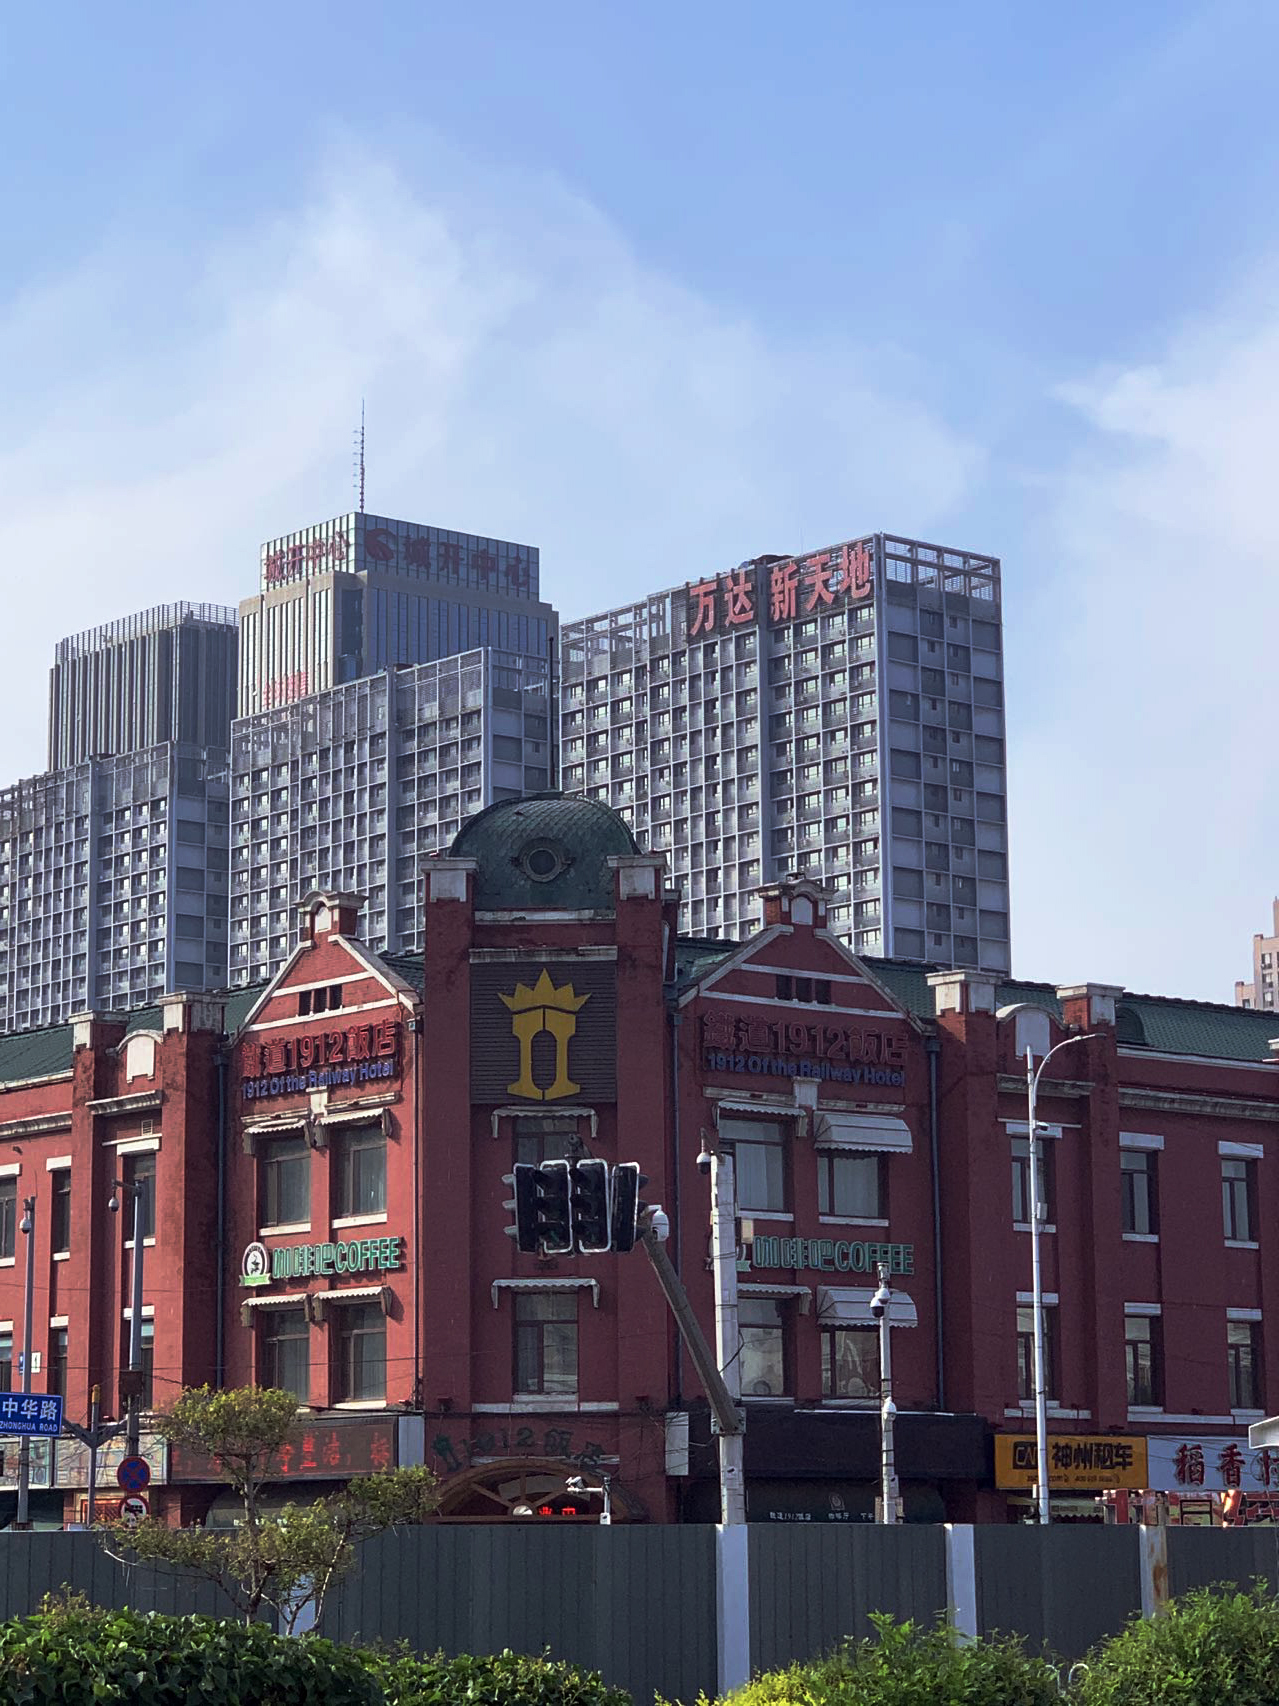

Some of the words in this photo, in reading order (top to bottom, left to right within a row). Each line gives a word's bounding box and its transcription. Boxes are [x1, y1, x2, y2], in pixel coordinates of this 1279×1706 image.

[689, 542, 871, 636] 万达新天地
[243, 1080, 268, 1099] 1912
[284, 1074, 306, 1092] the
[308, 1067, 359, 1088] Railway
[359, 1059, 394, 1080] Hotel
[708, 1053, 745, 1073] 1912
[749, 1055, 768, 1074] Of
[769, 1057, 798, 1077] the
[799, 1060, 860, 1084] Railway
[864, 1065, 905, 1087] Hotel
[272, 1242, 335, 1279] 咖啡吧
[335, 1236, 400, 1273] COFFEE
[753, 1235, 835, 1272] 咖啡吧
[835, 1240, 914, 1275] COFFEE
[0, 1421, 36, 1432] ZHONGHUA
[39, 1423, 58, 1432] ROAD
[2, 1397, 58, 1421] 中华路
[1052, 1441, 1134, 1471] 神州租车
